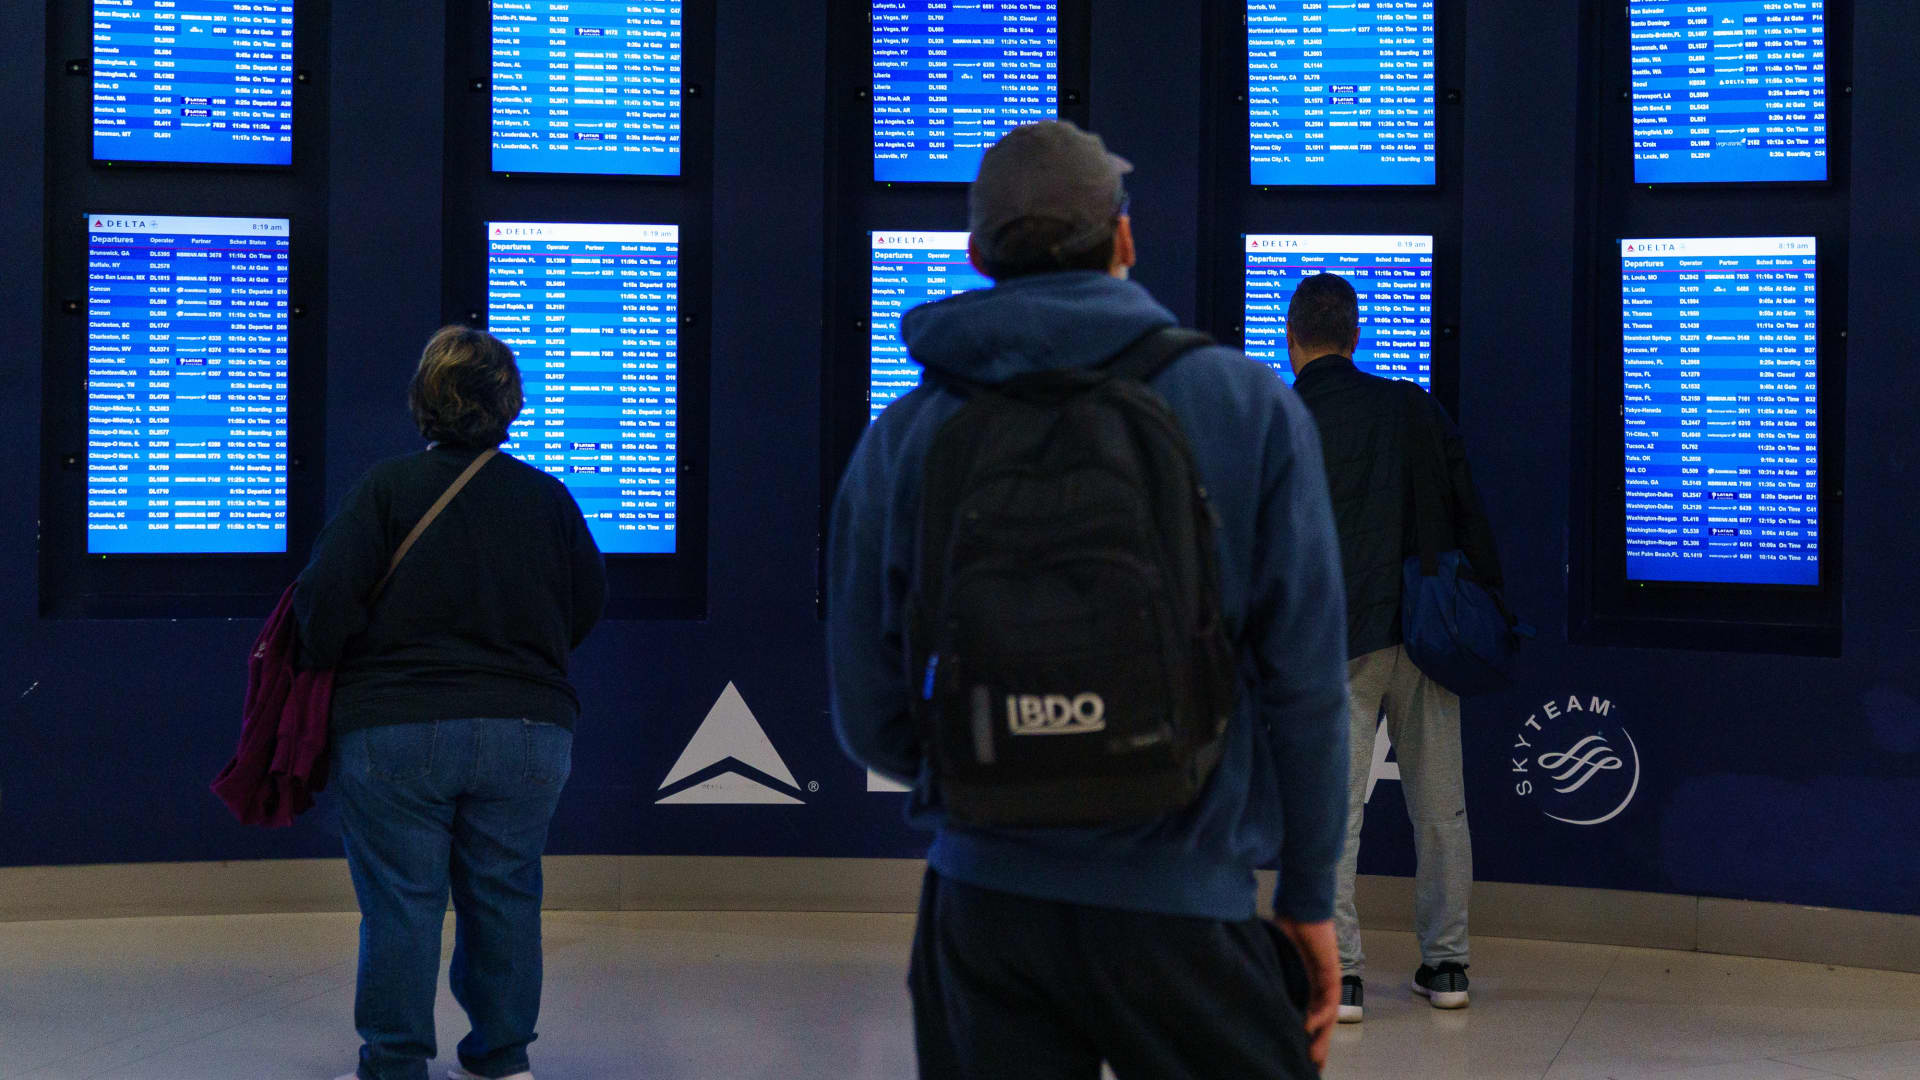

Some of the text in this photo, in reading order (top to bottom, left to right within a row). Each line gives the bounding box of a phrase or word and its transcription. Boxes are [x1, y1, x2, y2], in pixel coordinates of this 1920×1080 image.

[107, 220, 146, 228] DELTA
[492, 243, 531, 251] Departures
[1624, 260, 1664, 268] Departures
[1019, 692, 1105, 729] BDO
[1512, 695, 1611, 796] SKYTEAM
